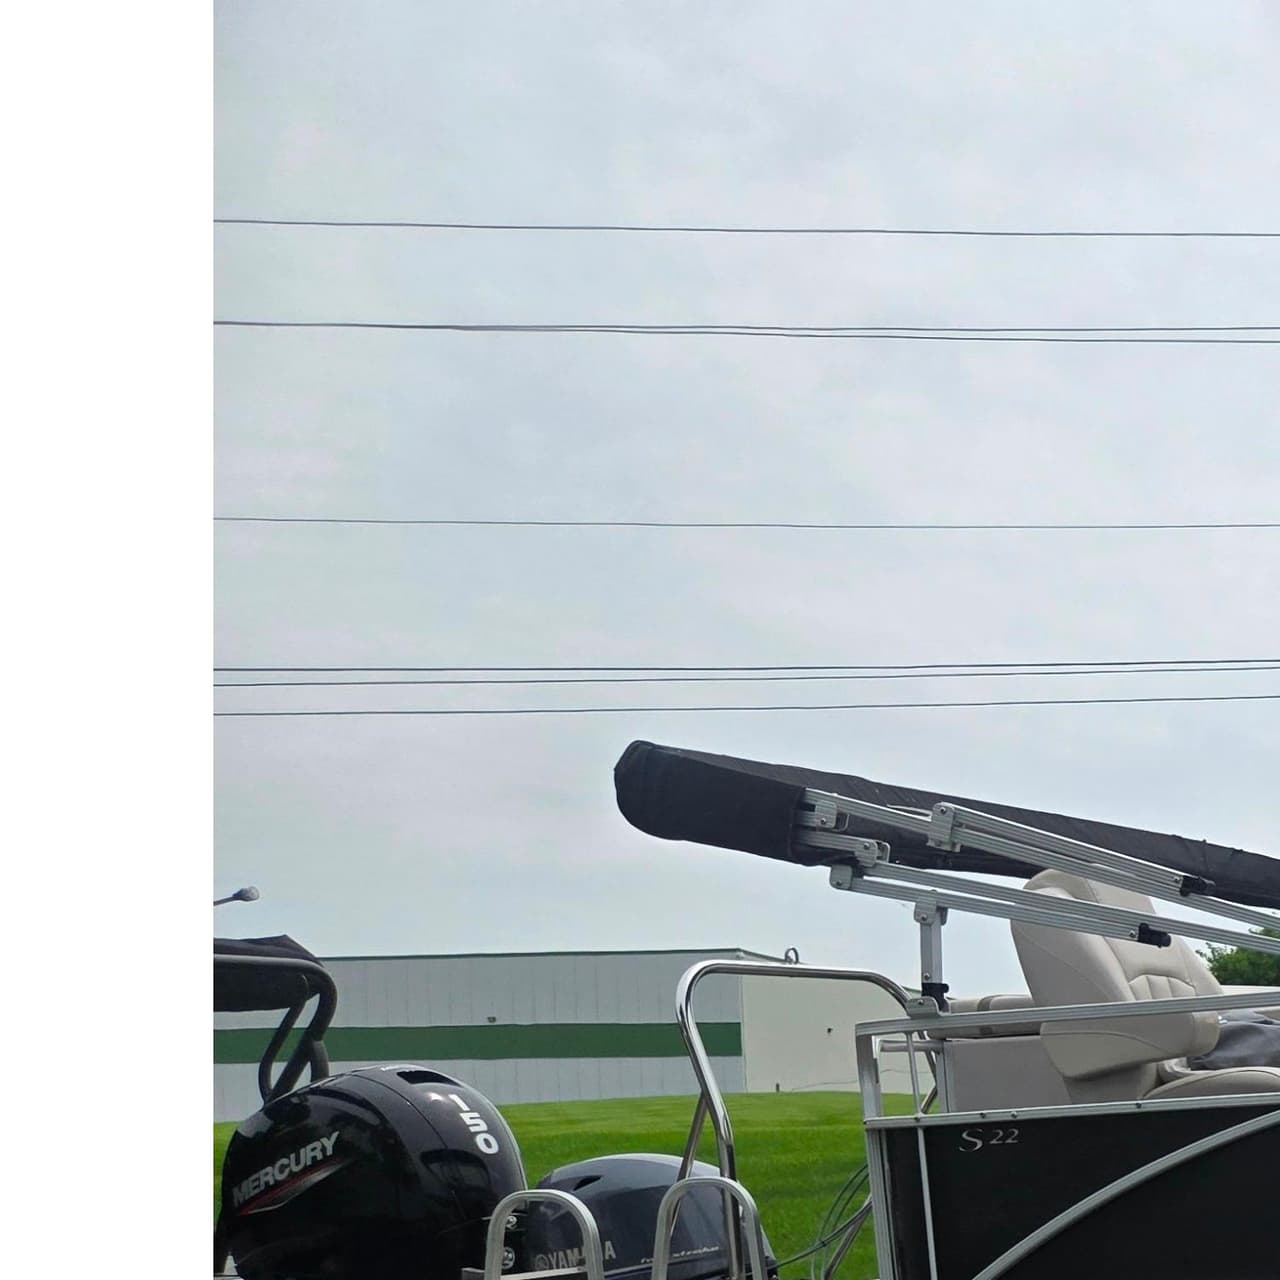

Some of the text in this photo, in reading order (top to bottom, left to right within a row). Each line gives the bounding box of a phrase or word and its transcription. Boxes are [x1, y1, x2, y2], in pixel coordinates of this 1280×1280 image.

[447, 1093, 499, 1155] 150
[989, 1128, 1019, 1144] 22
[231, 1130, 340, 1208] MERCURY
[547, 1240, 617, 1270] YAMA
